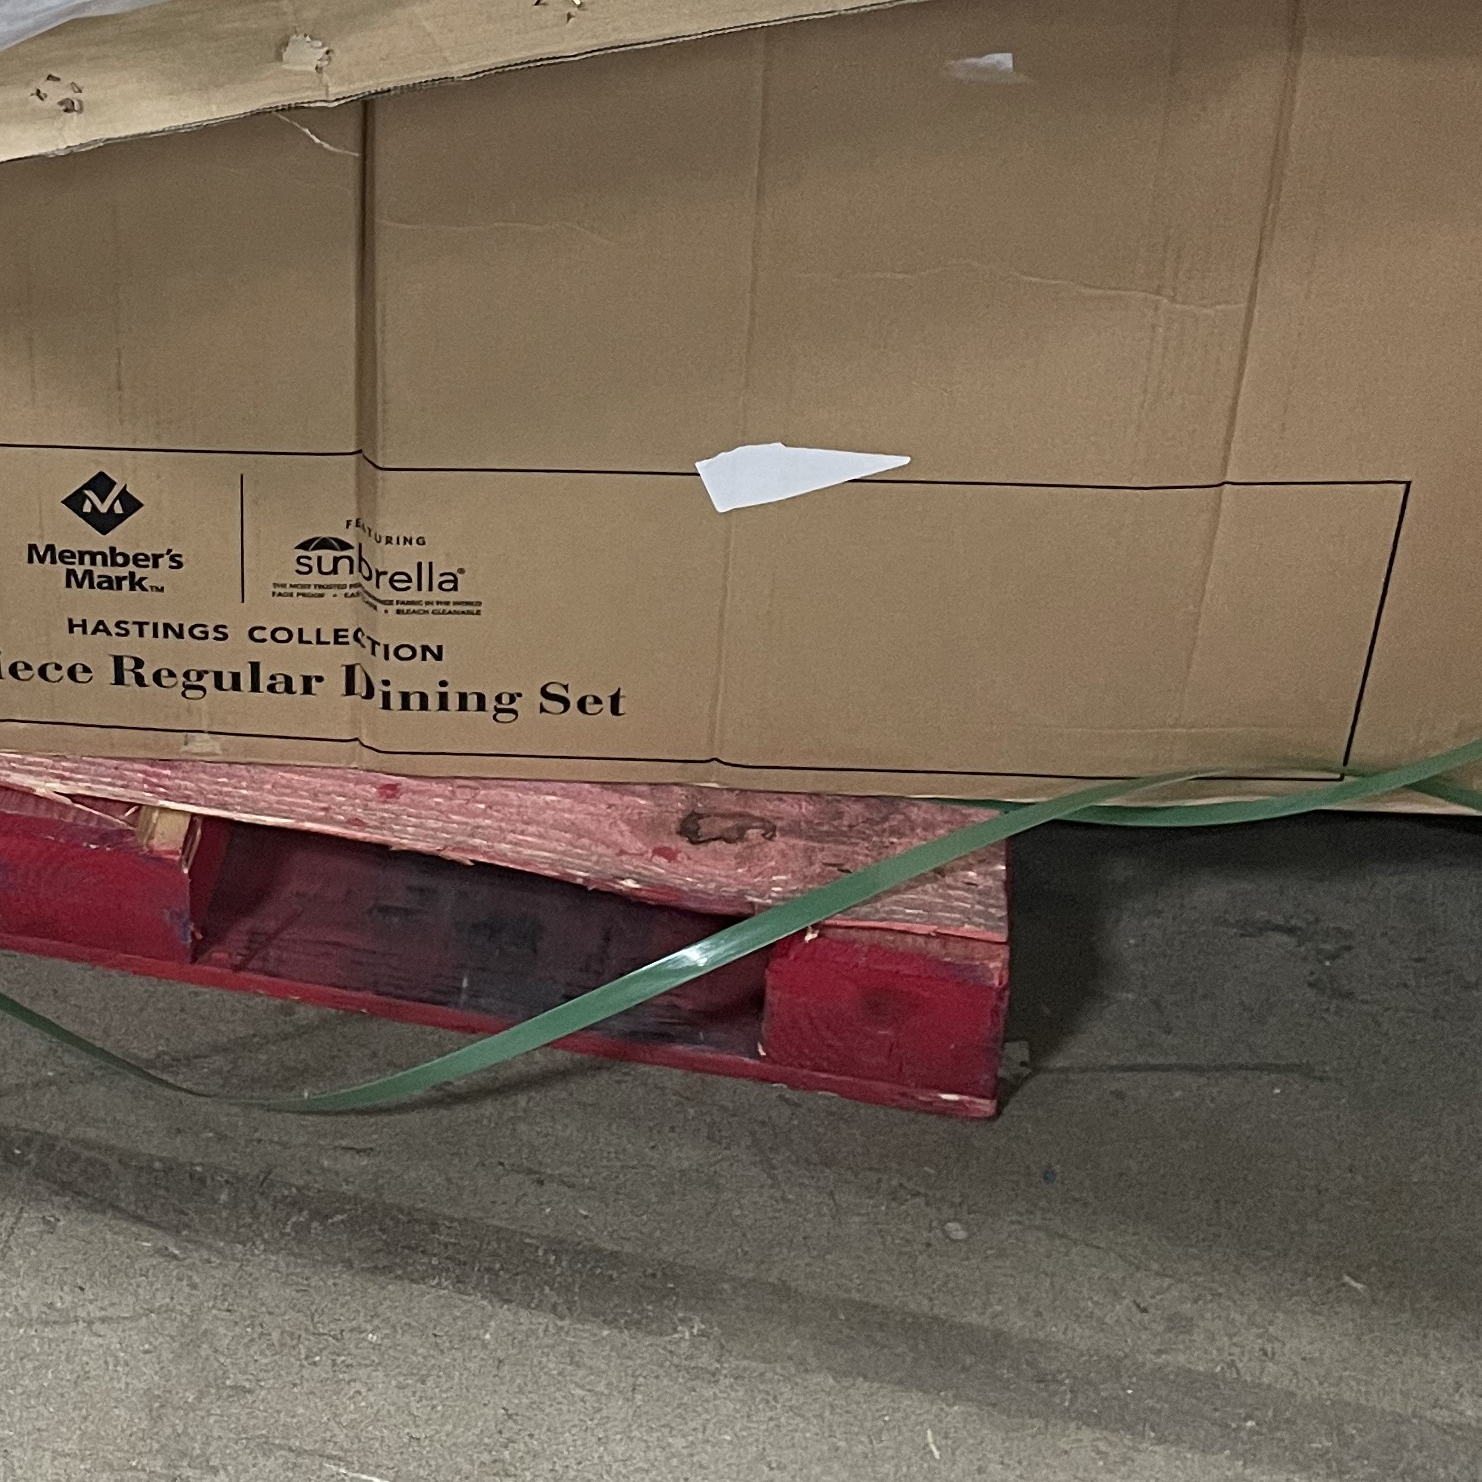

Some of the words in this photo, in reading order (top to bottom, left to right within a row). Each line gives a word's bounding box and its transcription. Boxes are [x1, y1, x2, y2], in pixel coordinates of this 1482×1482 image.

[26, 542, 185, 571] Member's
[67, 617, 231, 644] HASTINGS
[247, 625, 445, 664] COLLECTION
[109, 653, 326, 701] Regular
[342, 662, 523, 724] Dining
[538, 680, 628, 718] Set
